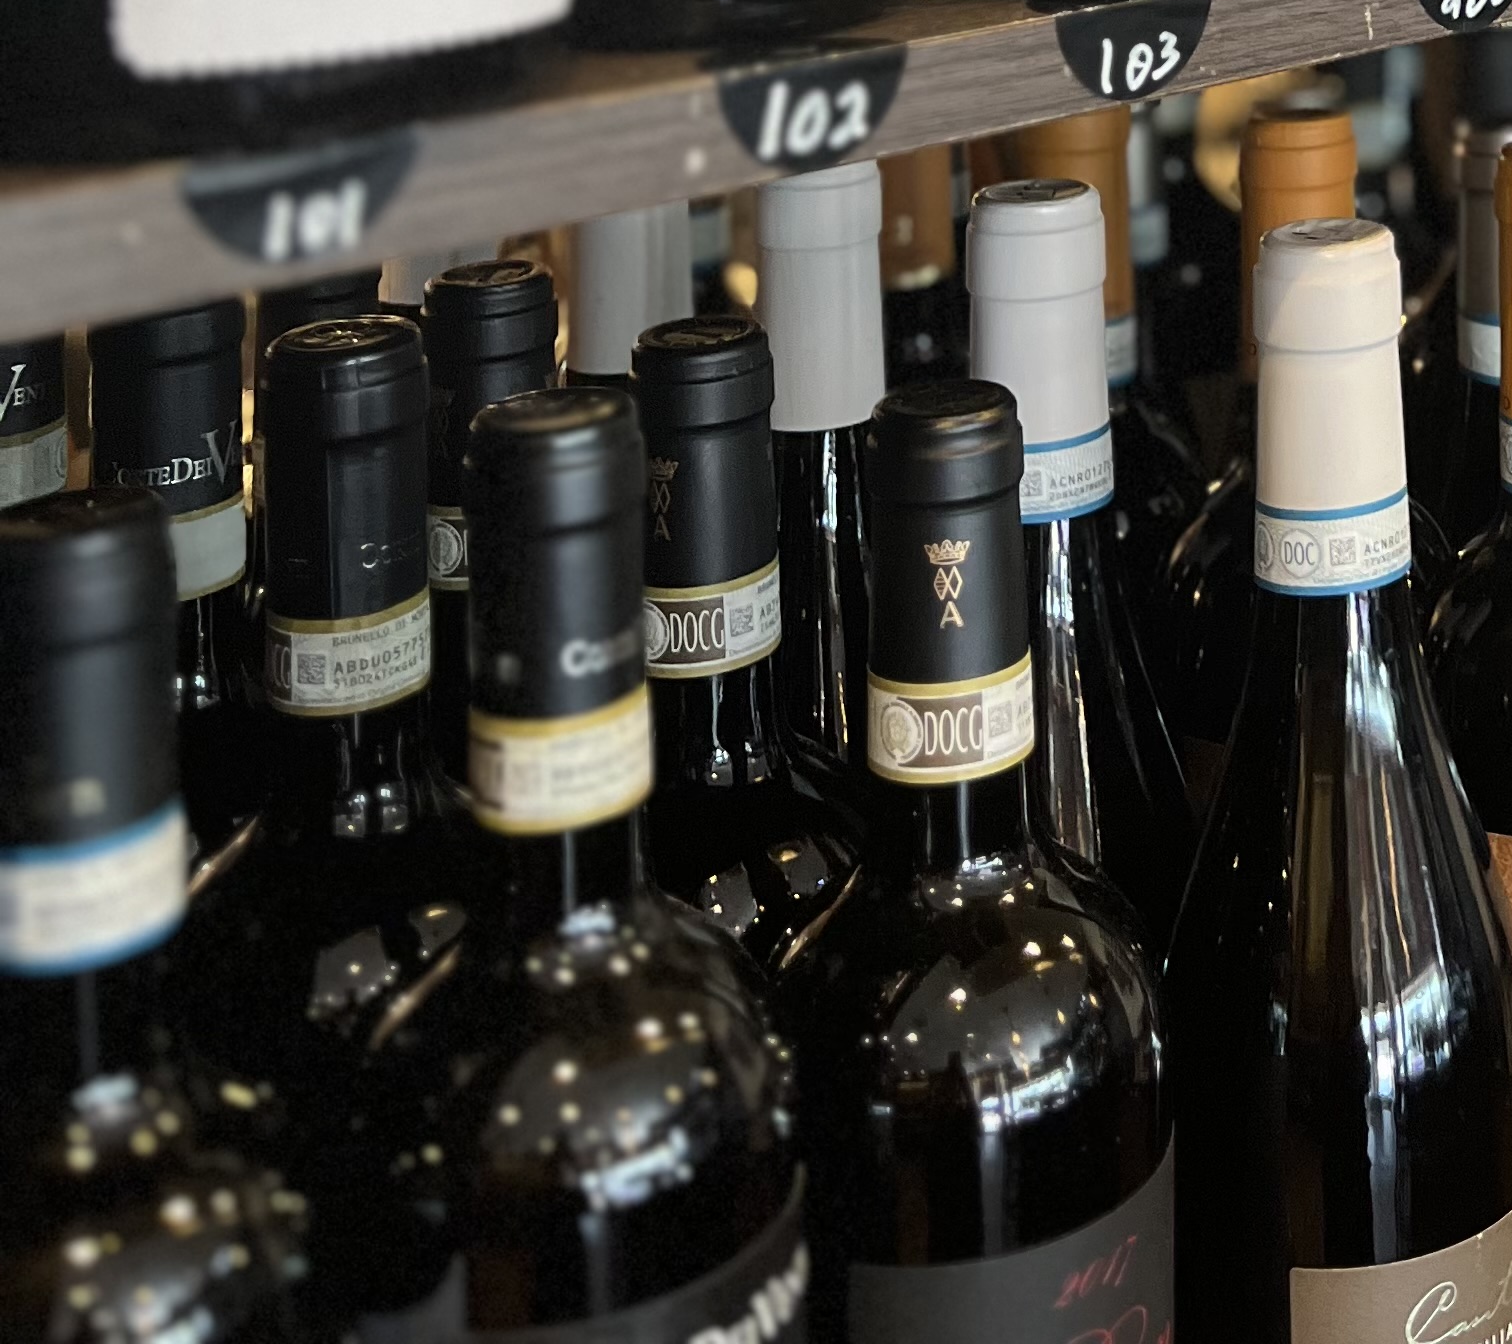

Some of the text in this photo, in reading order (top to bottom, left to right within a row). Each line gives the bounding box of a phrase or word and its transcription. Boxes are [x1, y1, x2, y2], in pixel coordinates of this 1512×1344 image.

[1101, 30, 1183, 95] 103
[756, 79, 870, 163] 102
[262, 176, 367, 264] 101
[1283, 540, 1317, 566] DOC
[331, 627, 391, 648] BRUNELLO
[669, 607, 724, 653] DOCG
[939, 600, 966, 630] A
[923, 705, 983, 757] DOCG
